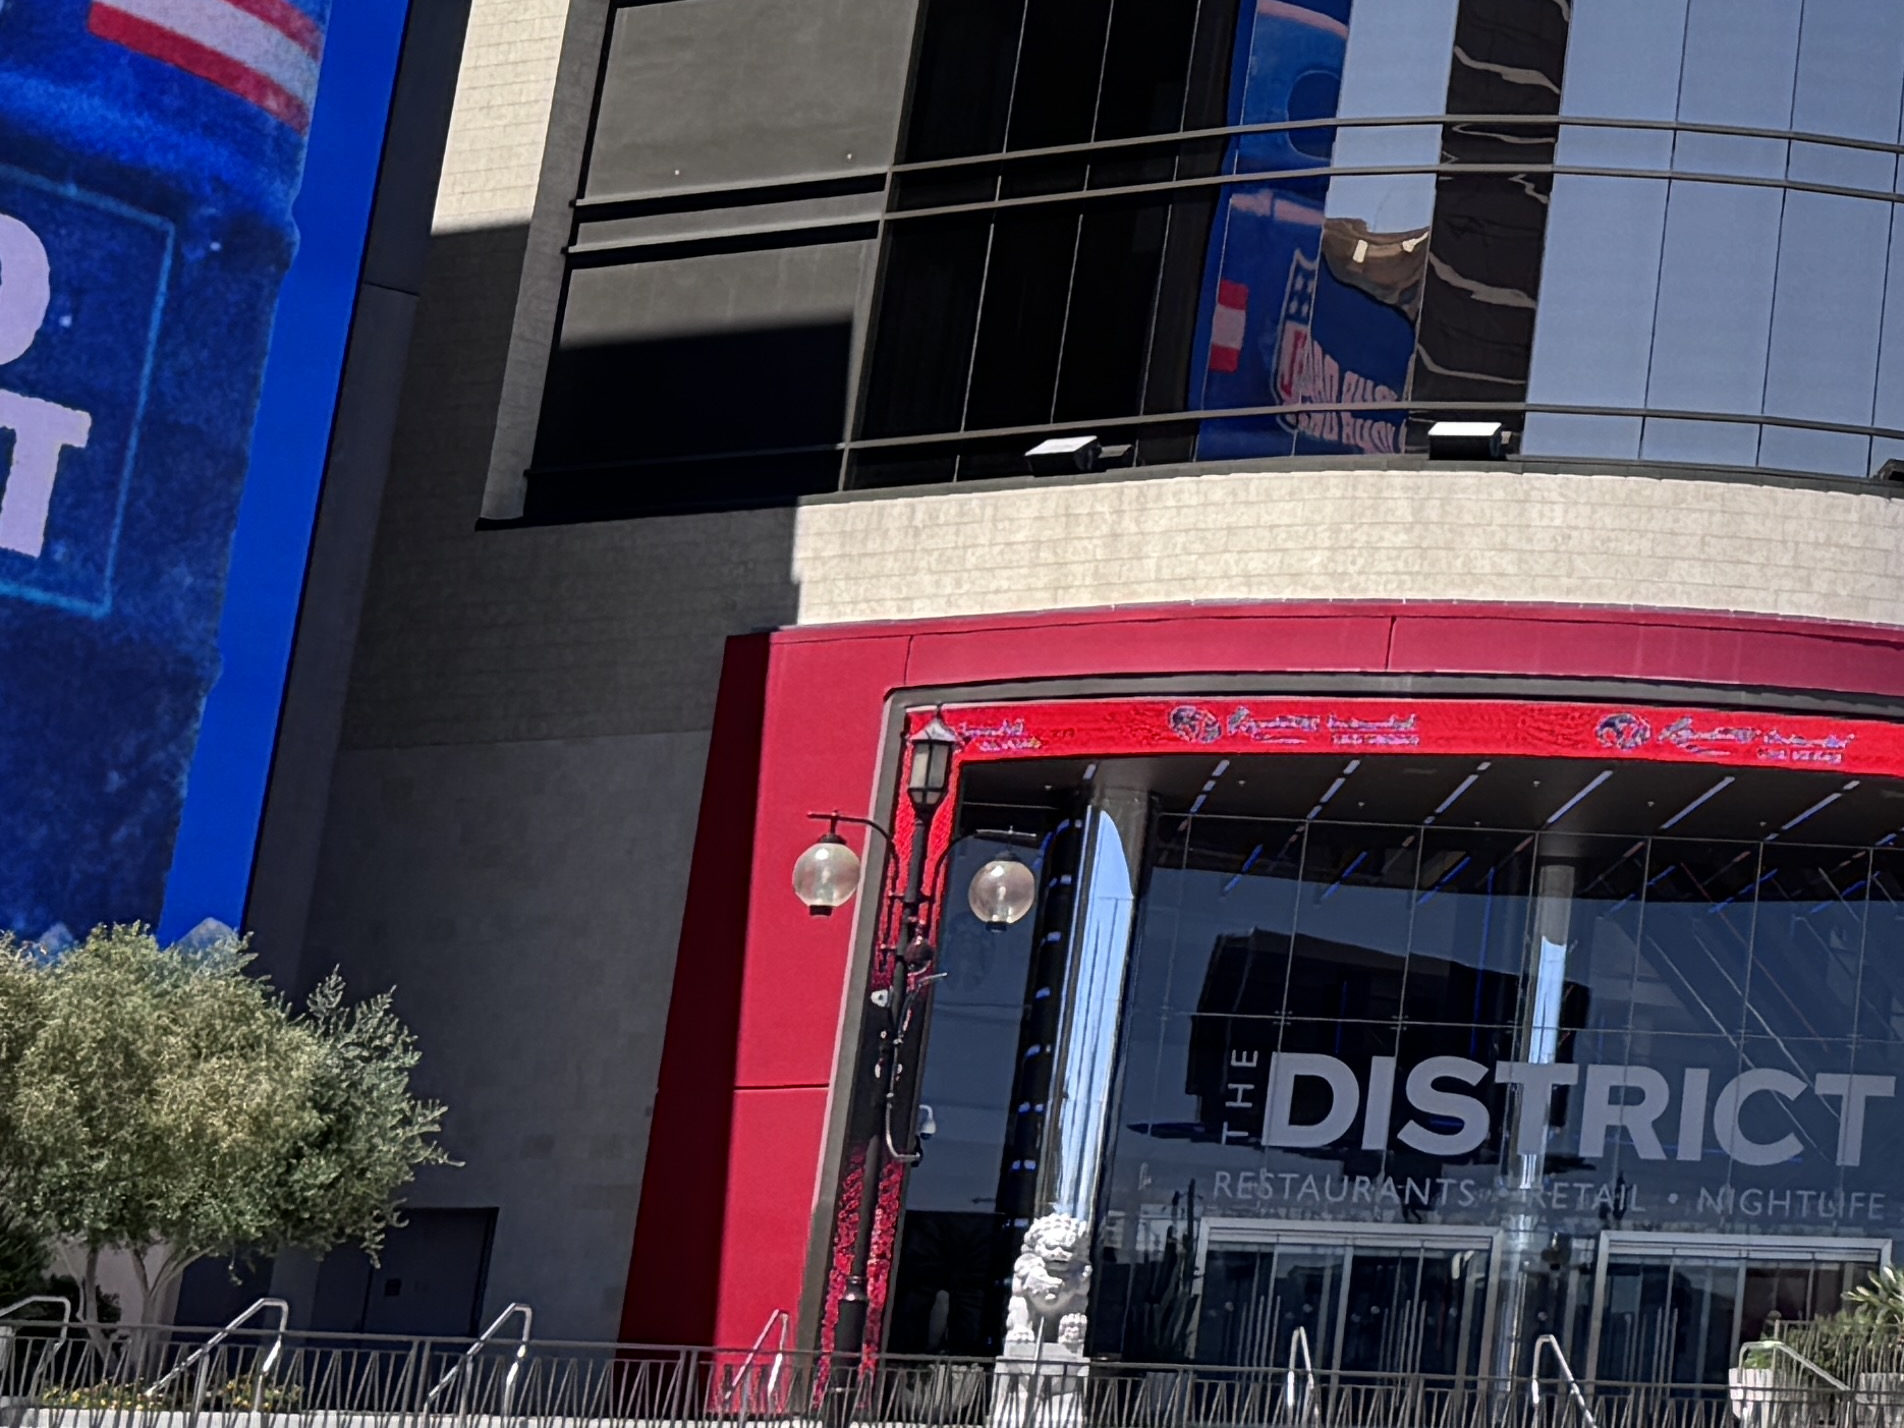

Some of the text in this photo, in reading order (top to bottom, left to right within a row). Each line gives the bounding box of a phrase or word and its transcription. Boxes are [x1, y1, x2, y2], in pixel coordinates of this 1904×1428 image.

[1221, 1049, 1259, 1145] THE
[1261, 1051, 1897, 1167] DISTRICT
[1213, 1170, 1887, 1221] RESTAURANTS RETAIL NIGHTLIFE
